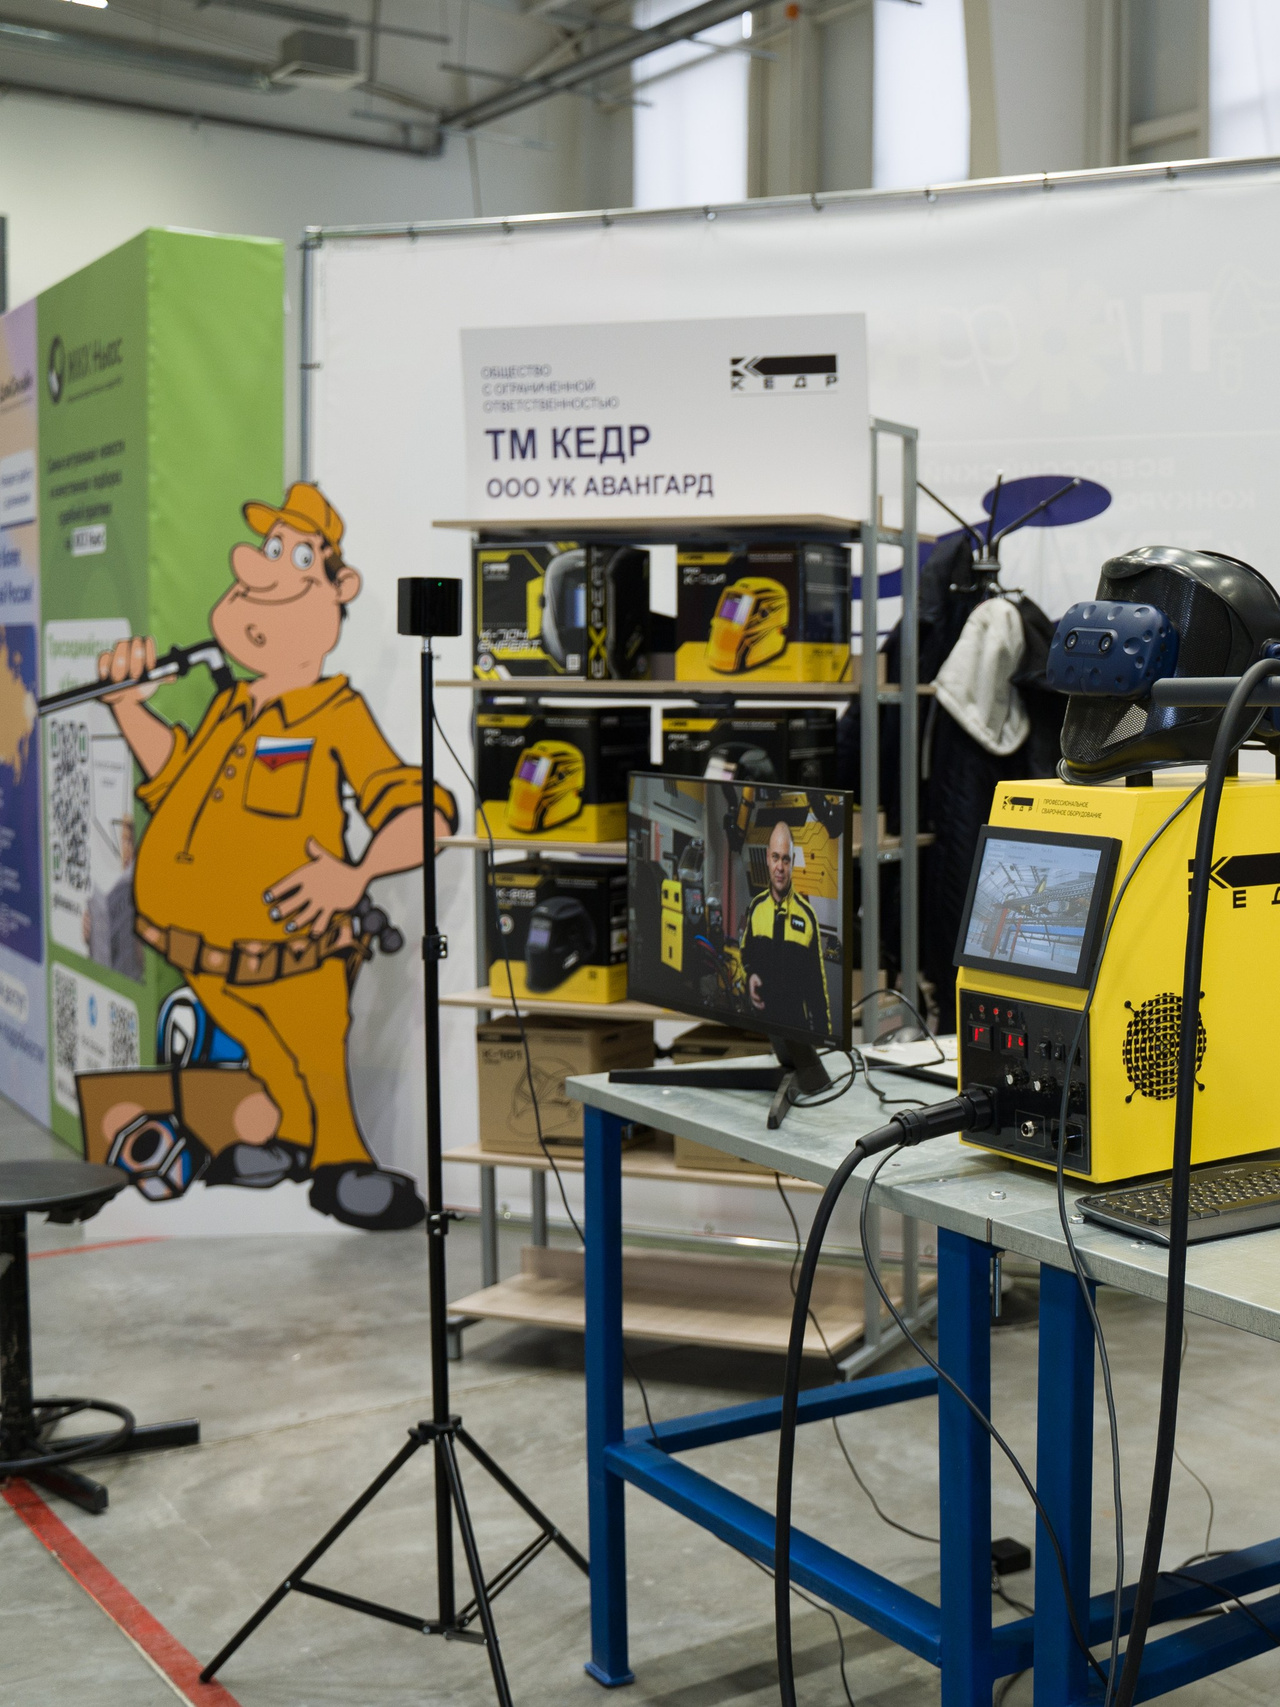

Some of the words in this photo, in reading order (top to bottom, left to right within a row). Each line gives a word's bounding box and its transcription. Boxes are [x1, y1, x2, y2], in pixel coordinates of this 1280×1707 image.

[481, 363, 552, 380] ОБЩЕСТВО
[482, 382, 492, 397] С
[494, 378, 597, 396] ОГРАНИЧЕННОЙ
[482, 395, 621, 414] ОТВЕТСТВЕННОСТЬЮ
[485, 428, 537, 460] ТМ
[552, 424, 651, 464] КЕДР
[486, 477, 540, 499] ООО
[549, 475, 576, 497] УК
[583, 472, 715, 499] АВАНГАРД
[1042, 797, 1089, 809] ПРОФЕССИОНАЛЬНОЕ
[1041, 808, 1067, 817] СВАРОЧНОЕ
[1066, 809, 1103, 819] ОБОРУДОВАНИЕ
